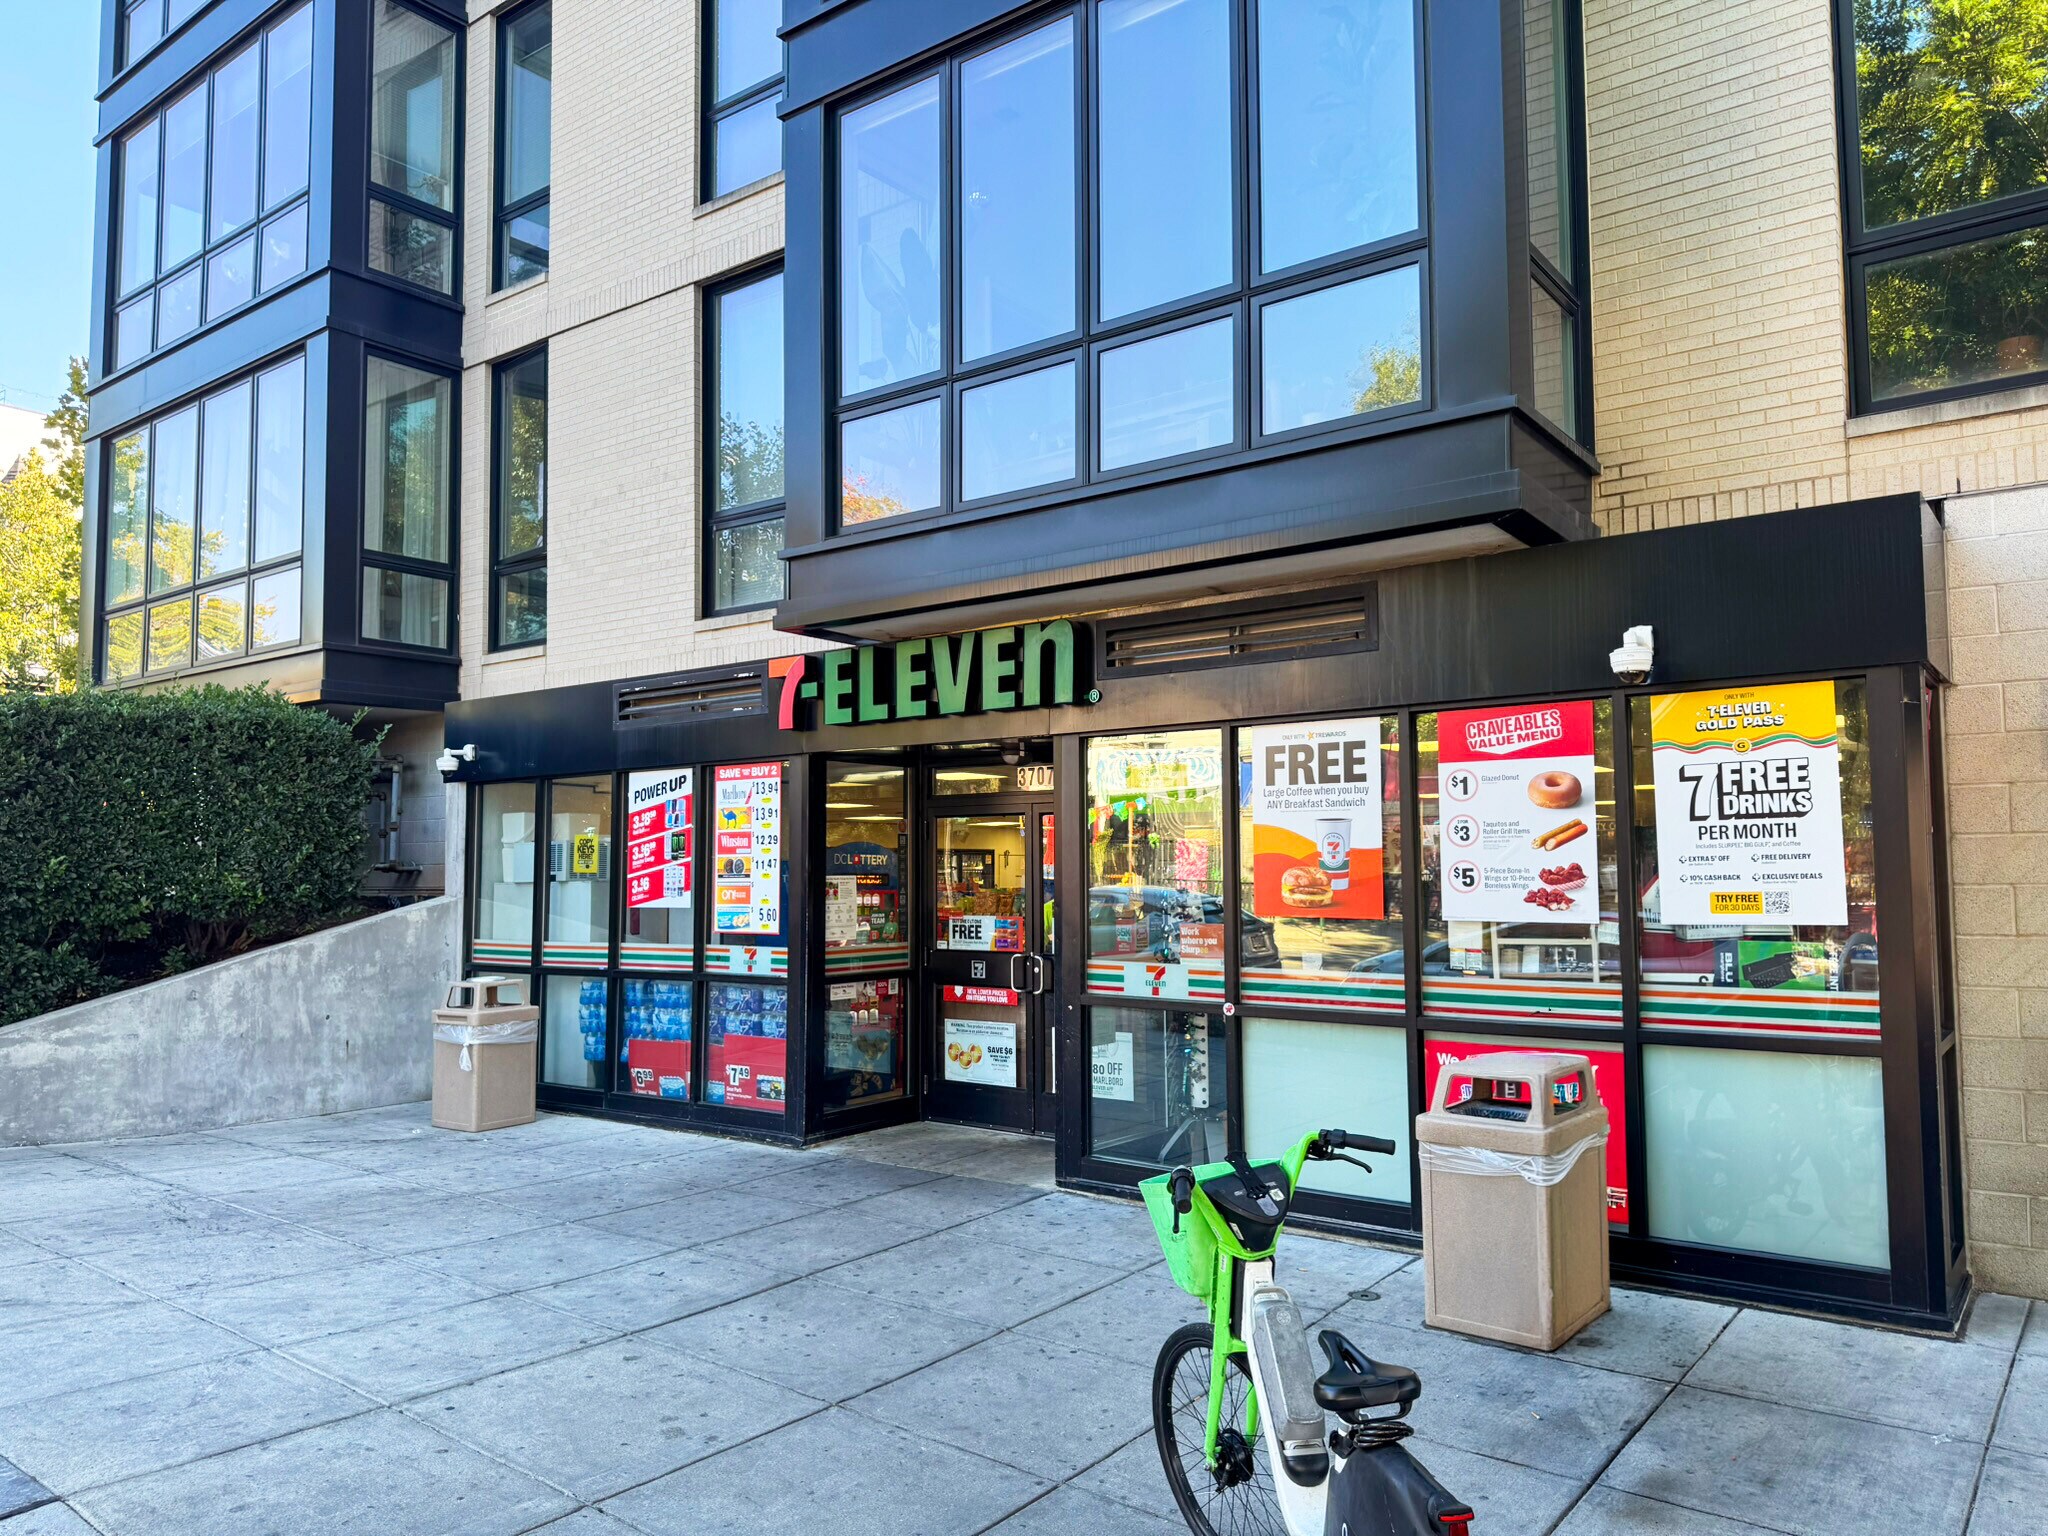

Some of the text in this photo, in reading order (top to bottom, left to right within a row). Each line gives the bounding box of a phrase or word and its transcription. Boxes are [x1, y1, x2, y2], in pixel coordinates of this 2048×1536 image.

[1467, 710, 1560, 739] CRAVEABLES
[1696, 715, 1785, 731] GOLD PASS
[1468, 728, 1561, 750] VALUE MENU
[1265, 740, 1367, 786] FREE
[720, 768, 741, 778] SAVE
[751, 766, 769, 776] BUY
[771, 766, 777, 774] 2
[1019, 766, 1054, 786] 3707
[1719, 757, 1811, 795] FREE
[634, 774, 687, 804] POWER UP
[1263, 785, 1369, 798] Large Coffee when you buy
[1451, 776, 1468, 795] $1
[1679, 763, 1720, 821] 7
[1267, 797, 1365, 809] ANY Breakfast Sandwich
[1719, 792, 1813, 820] DRINKS
[1454, 825, 1470, 841] $3
[1698, 823, 1797, 840] PER MONTH
[721, 835, 748, 847] Winston
[577, 845, 594, 853] KEYS
[1454, 867, 1475, 887] $5
[1512, 882, 1529, 890] Wings
[1715, 893, 1759, 903] TRY FREE
[1741, 903, 1760, 911] DAYS
[952, 925, 982, 940] FREE
[1181, 927, 1199, 935] Work
[1181, 937, 1217, 946] where you
[1181, 946, 1209, 954] Slurpee
[1724, 952, 1734, 983] BLU
[1146, 965, 1166, 996] 7
[988, 1046, 1013, 1055] SAVE $6
[1107, 1062, 1123, 1075] OFF
[1094, 1076, 1123, 1086] MARLBORO
